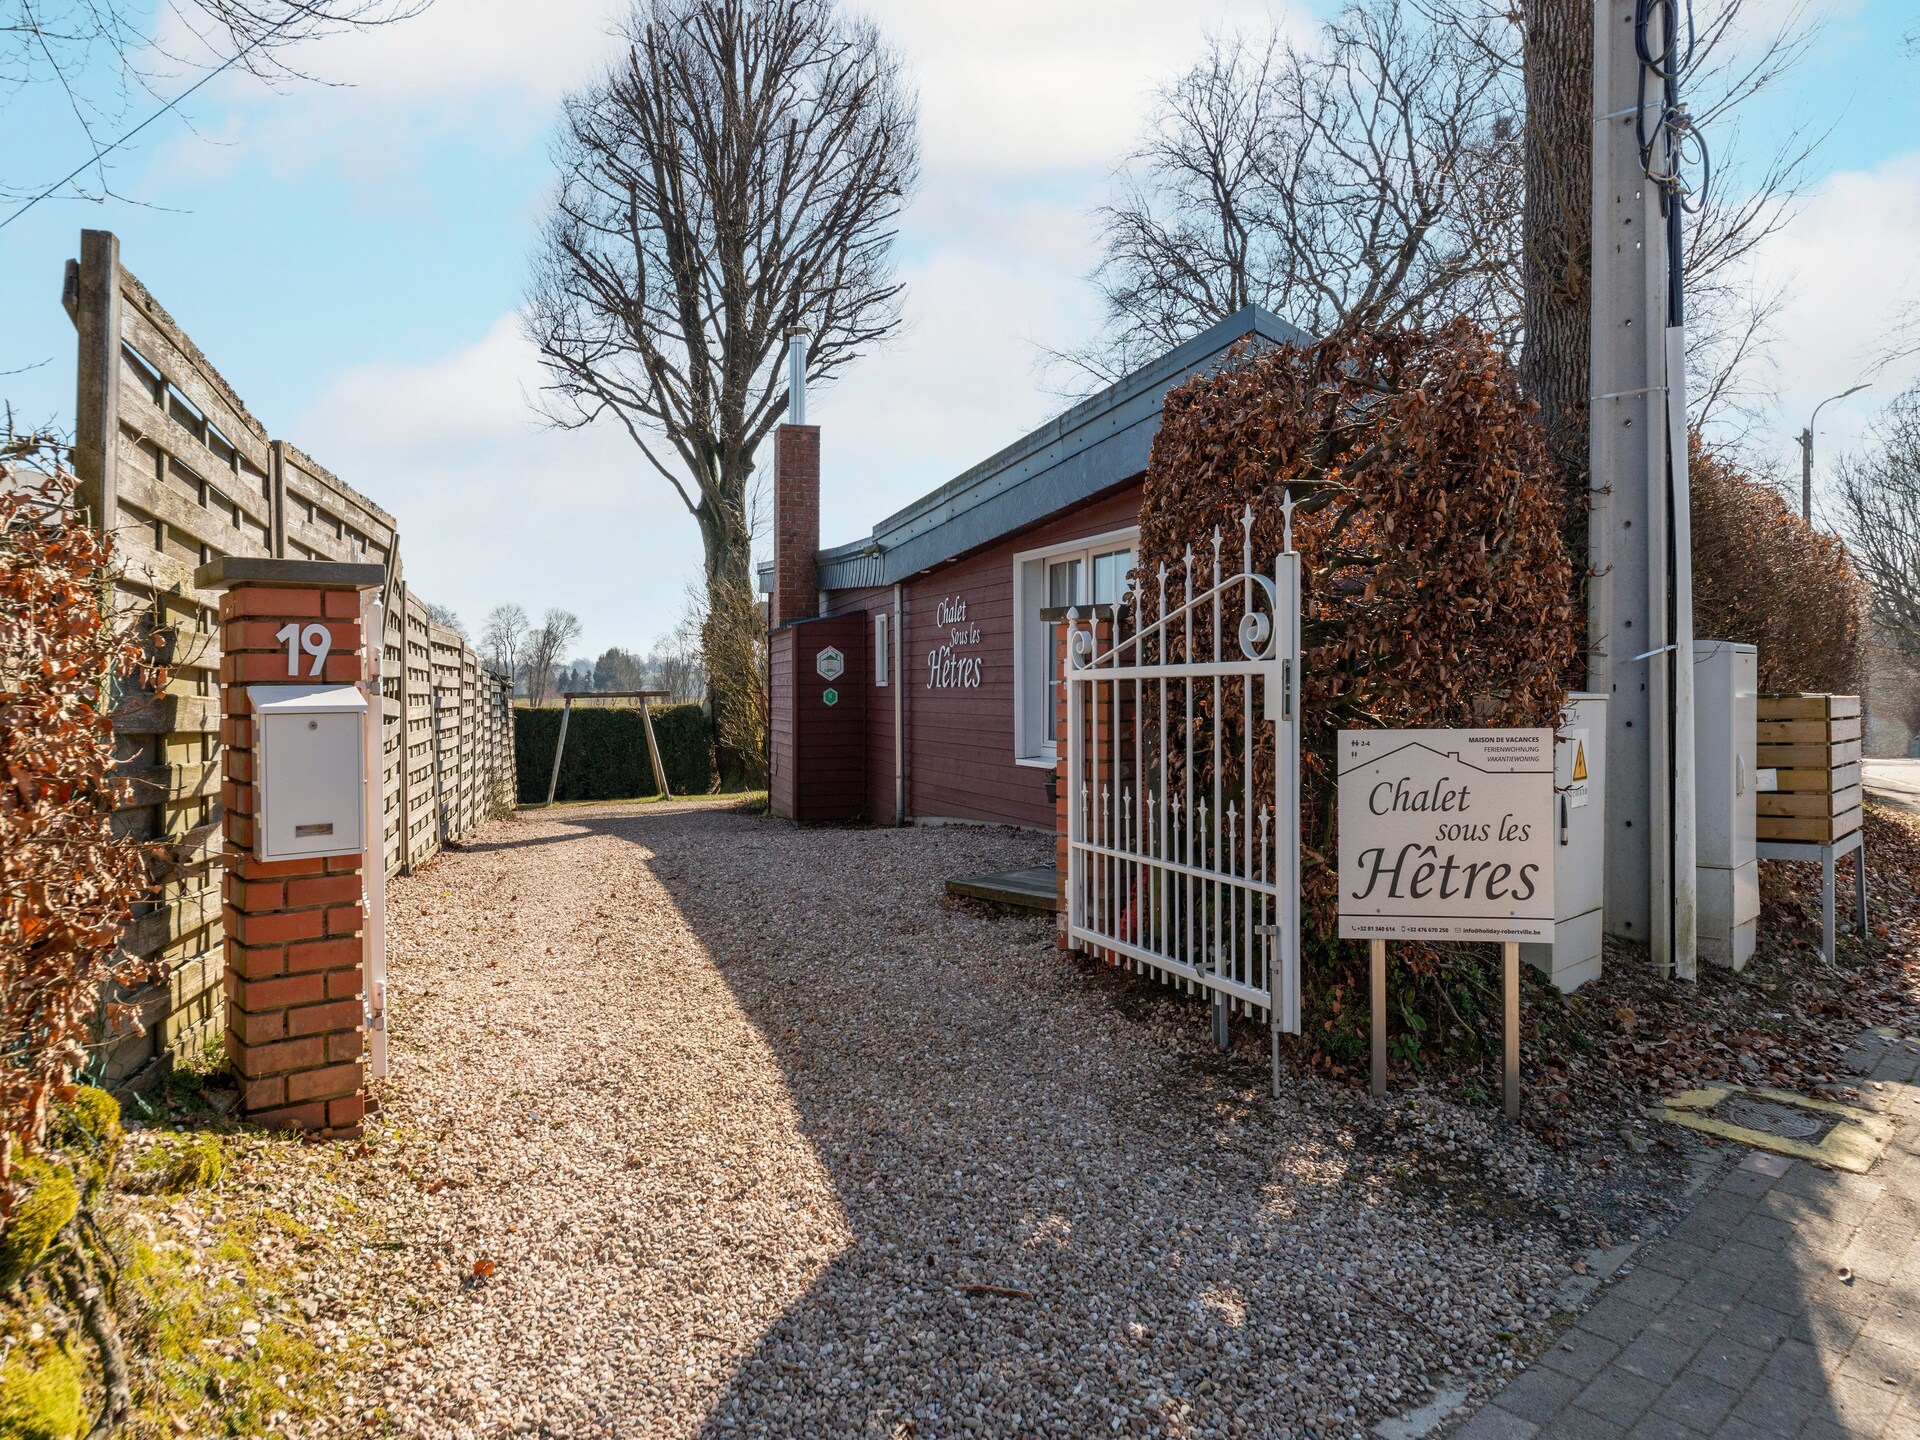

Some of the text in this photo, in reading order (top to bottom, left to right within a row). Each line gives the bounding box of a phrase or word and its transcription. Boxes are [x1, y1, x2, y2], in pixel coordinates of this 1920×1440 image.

[937, 595, 967, 628] Chalet
[275, 623, 332, 677] 19
[969, 621, 980, 644] les
[926, 645, 982, 690] Hêtres
[1368, 776, 1471, 816] Chalet
[1435, 813, 1532, 842] sous les
[1351, 843, 1540, 901] Hêtres
[1463, 927, 1541, 936] info@holiday-robertville.be
